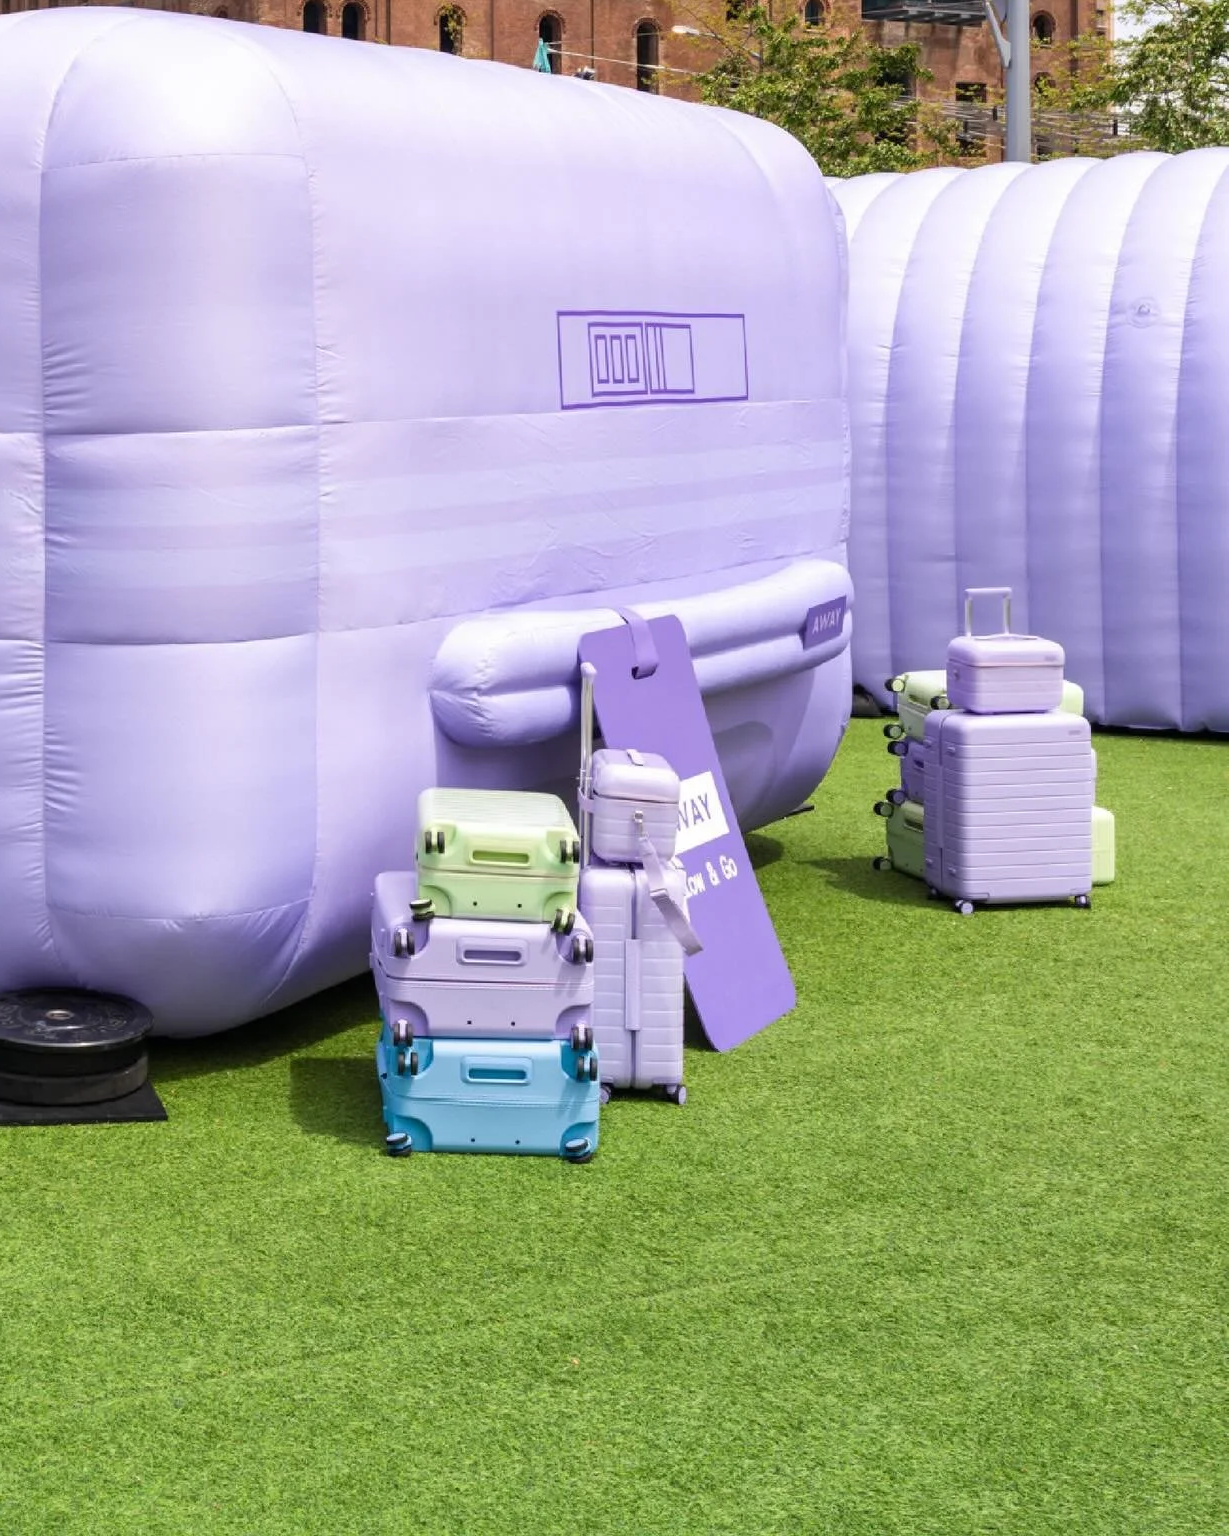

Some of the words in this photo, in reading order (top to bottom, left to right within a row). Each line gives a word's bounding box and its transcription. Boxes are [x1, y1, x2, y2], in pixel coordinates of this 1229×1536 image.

[812, 607, 842, 635] AWAY
[677, 792, 712, 832] WAY
[706, 861, 721, 887] &
[719, 855, 738, 880] Go
